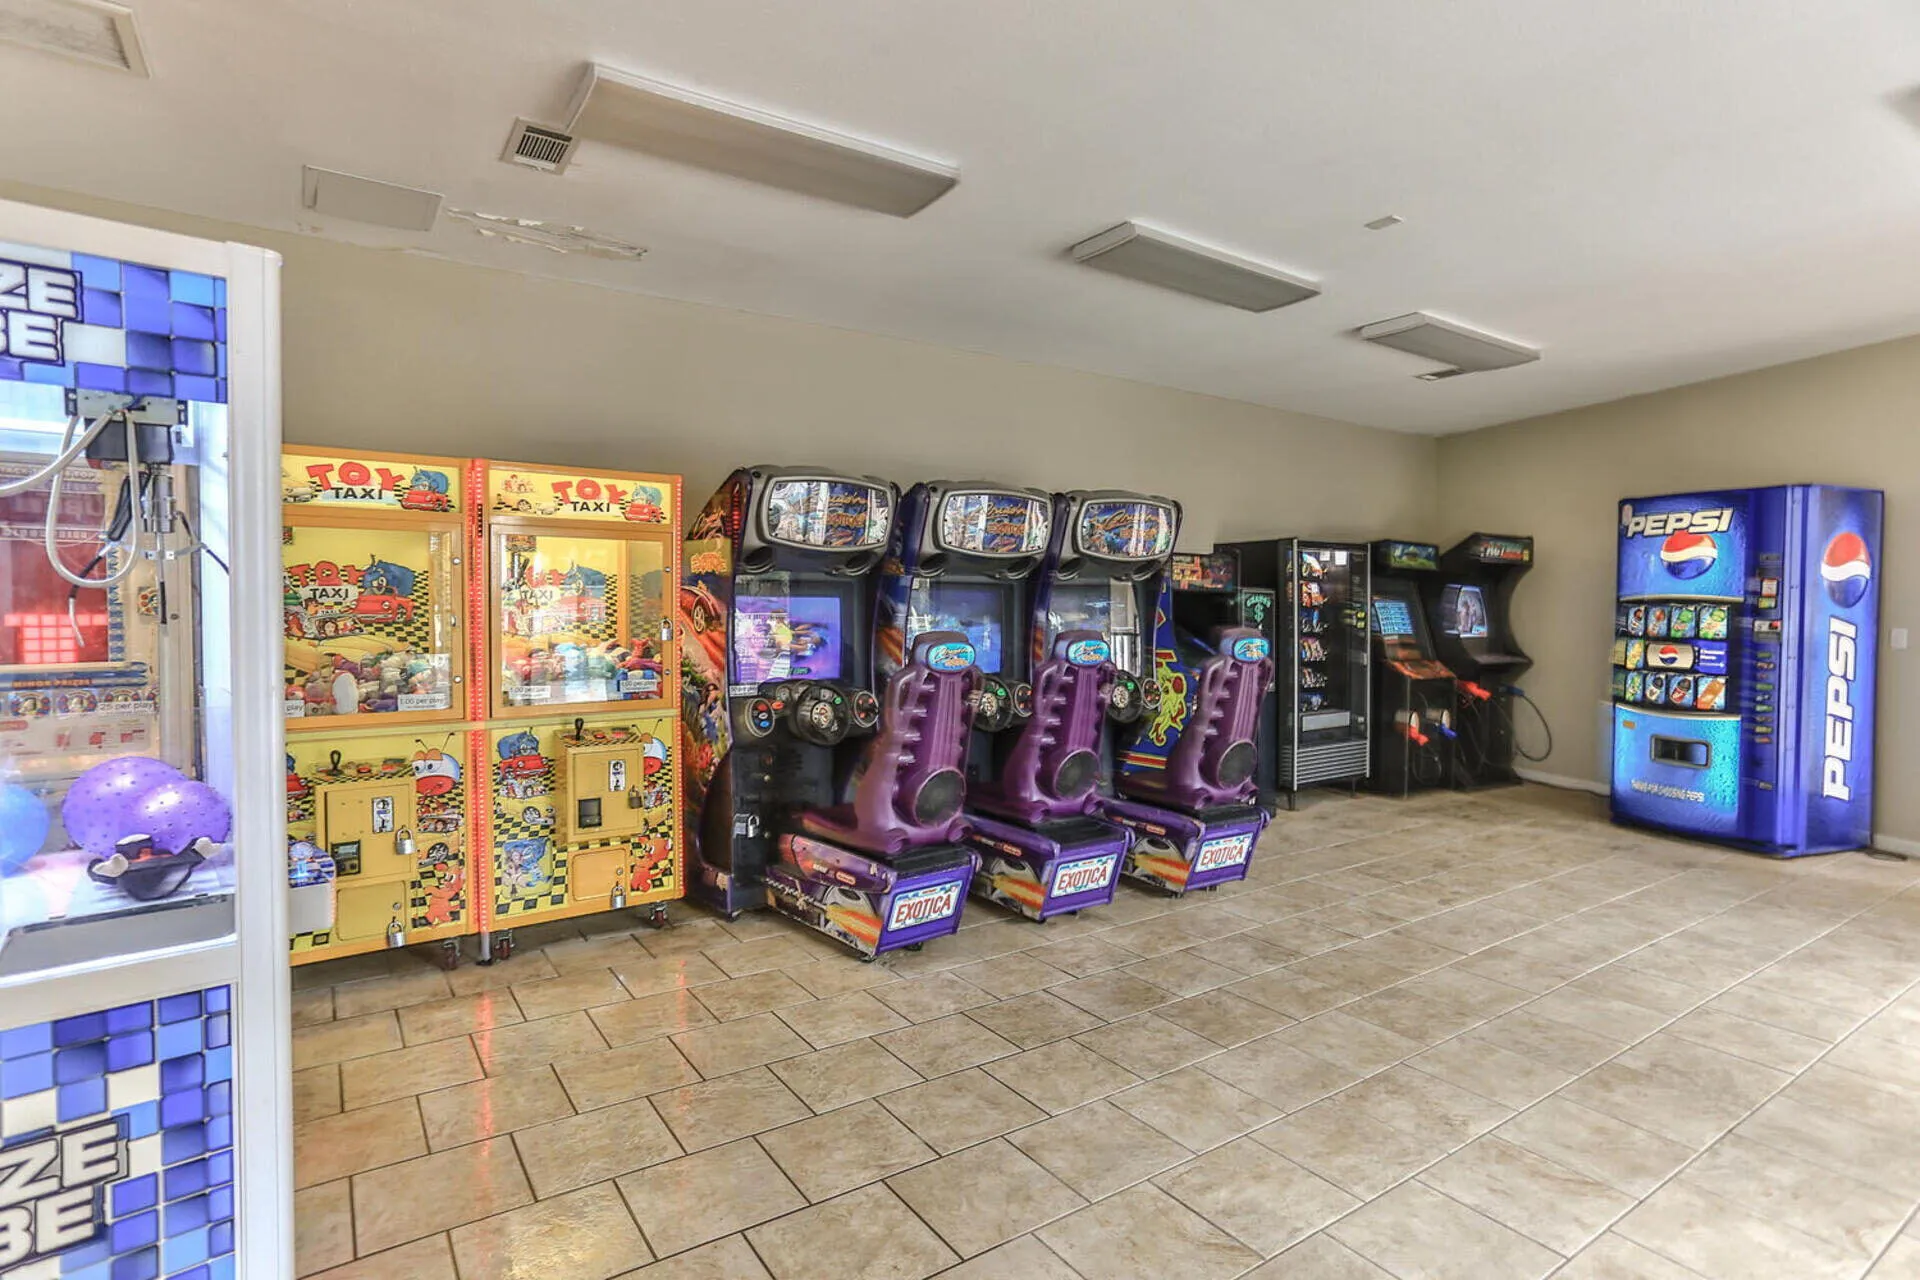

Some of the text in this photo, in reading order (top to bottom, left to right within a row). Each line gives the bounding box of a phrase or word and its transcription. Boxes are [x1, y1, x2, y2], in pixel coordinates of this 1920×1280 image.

[306, 461, 405, 491] TOY
[331, 487, 383, 500] TAXI
[551, 478, 628, 505] TOY
[570, 501, 610, 513] TAXI
[1626, 507, 1734, 538] PEPSI
[284, 561, 366, 588] TOY
[309, 588, 349, 600] TAXI
[1823, 616, 1857, 801] PEPSI
[1201, 845, 1243, 866] EXOTICA
[1058, 866, 1107, 890] EXOTICA
[895, 894, 951, 923] EXOTICA
[0, 1122, 119, 1206] ZE
